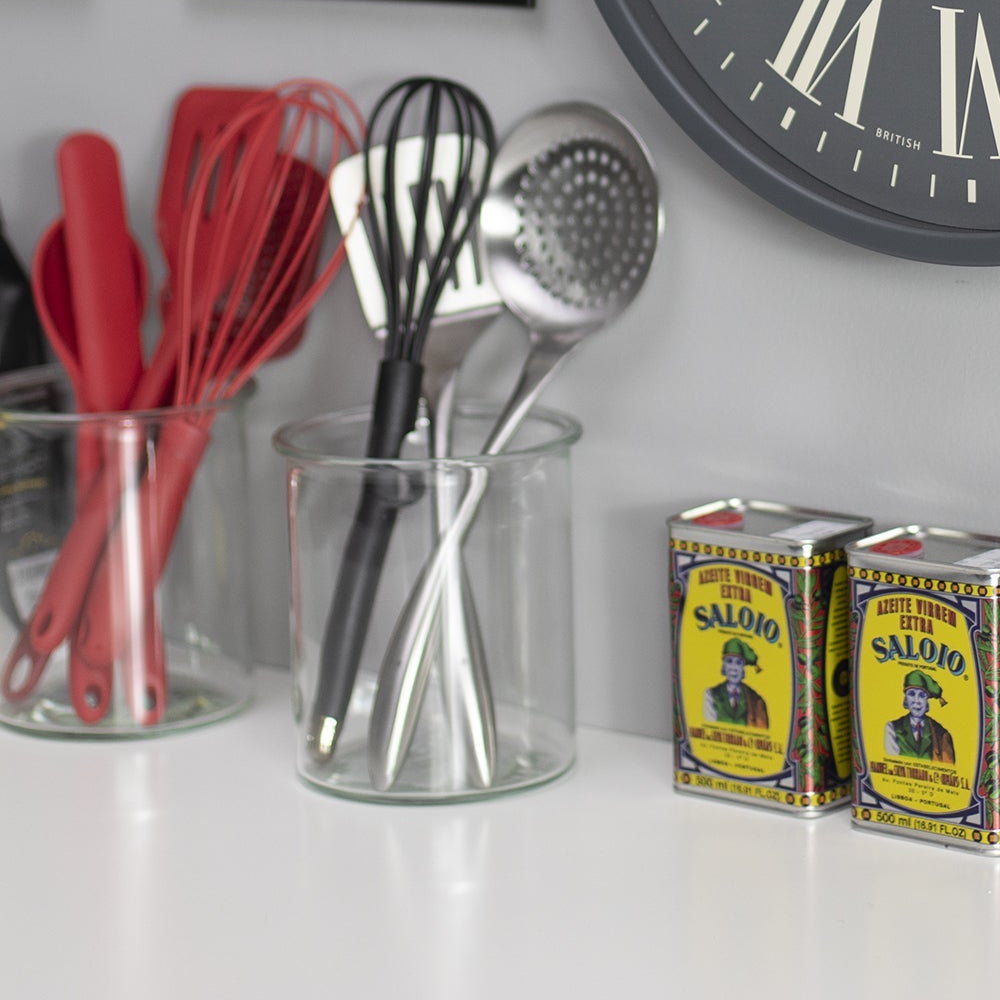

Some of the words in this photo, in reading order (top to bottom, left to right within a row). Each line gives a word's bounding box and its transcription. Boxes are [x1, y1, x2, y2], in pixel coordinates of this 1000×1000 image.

[875, 127, 921, 151] BRITISH
[693, 603, 780, 644] SALOIO
[877, 598, 911, 616] AZEITE
[914, 599, 957, 628] VIRGEM
[900, 614, 934, 635] EXTRA
[872, 635, 966, 676] SALOIO
[876, 811, 895, 824] 500
[898, 816, 911, 827] ml
